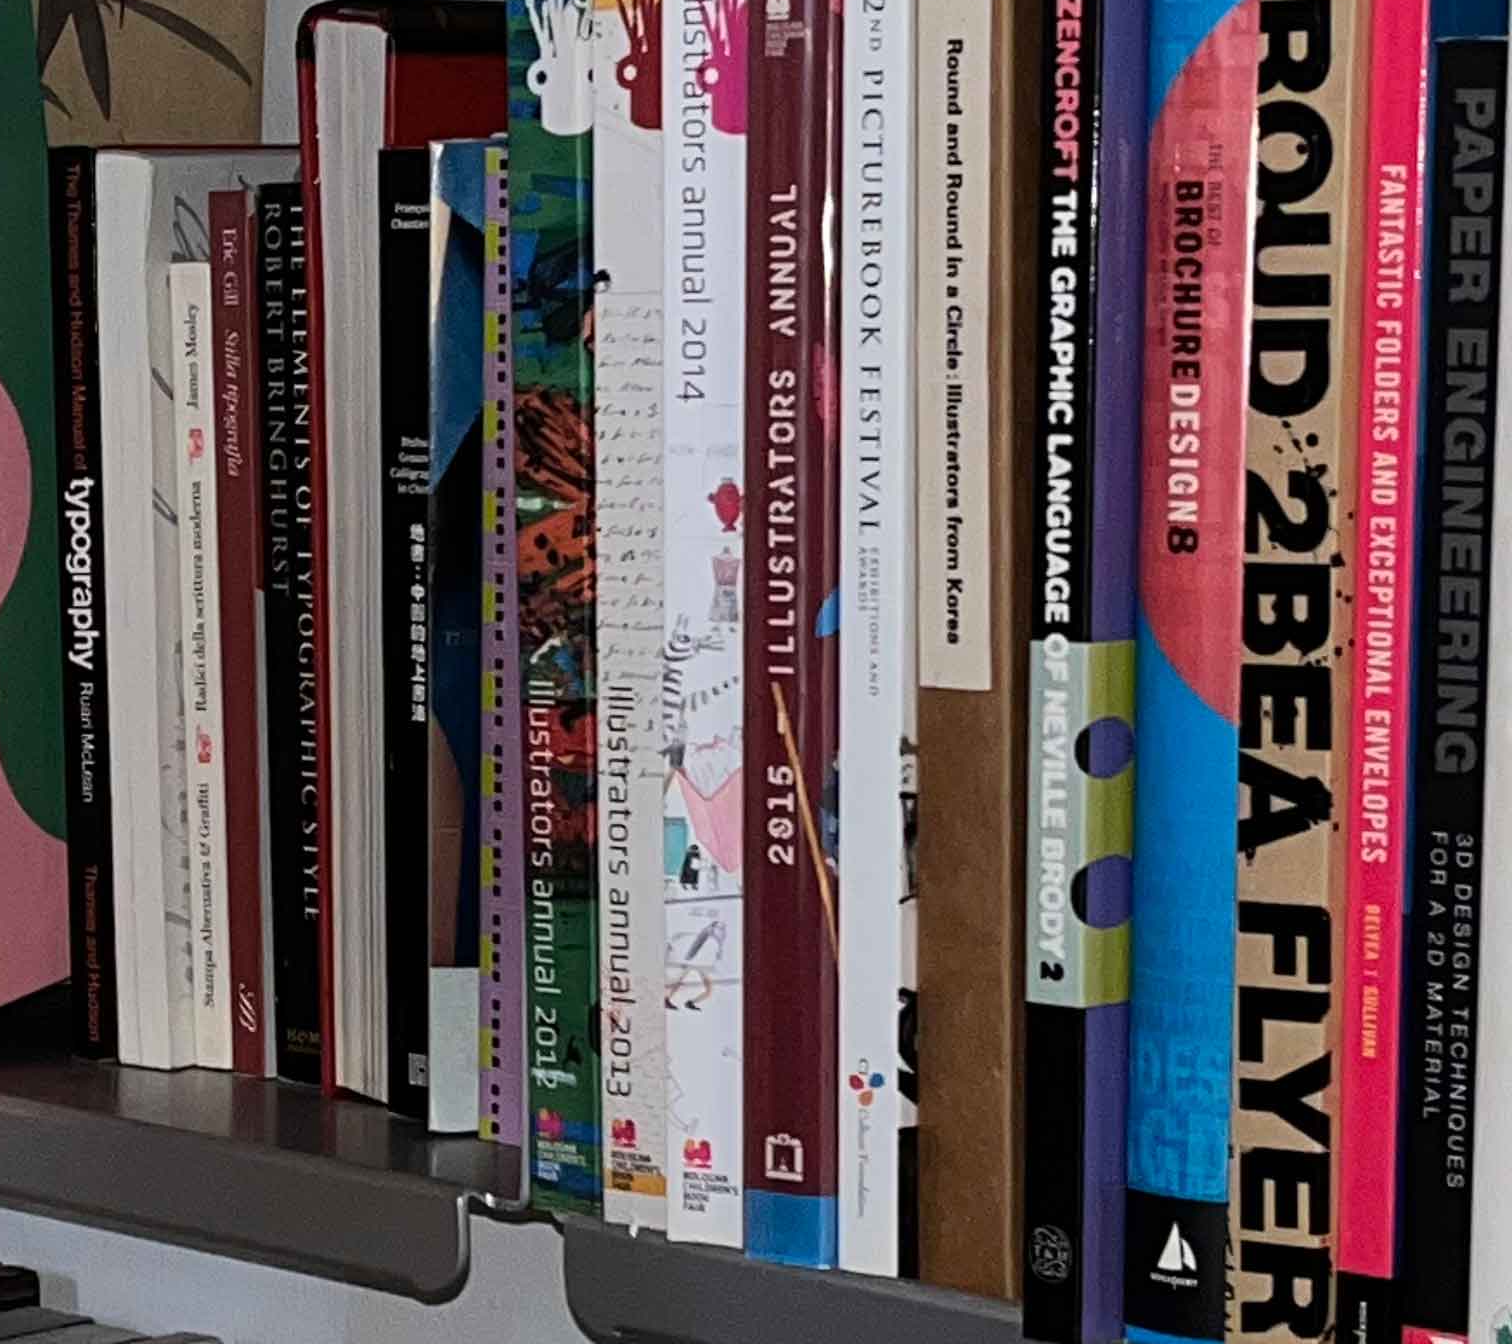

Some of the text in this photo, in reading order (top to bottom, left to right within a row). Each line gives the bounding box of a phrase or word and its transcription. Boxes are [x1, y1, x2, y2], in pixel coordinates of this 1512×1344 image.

[945, 38, 964, 116] Round
[946, 123, 964, 166] and
[681, 186, 713, 305] annual
[945, 172, 963, 251] Round
[946, 256, 963, 280] in
[1051, 190, 1078, 259] THE
[946, 285, 959, 299] a
[1048, 267, 1076, 424] GRAPHIC
[263, 203, 290, 600] ROBERT BRINGHURST
[675, 317, 708, 404] 2014
[769, 184, 797, 674] ILLUSTRATORS ANNUAL
[945, 385, 963, 509] Illustrators
[1434, 88, 1496, 775] PAPER ENGINEERING
[945, 515, 962, 571] from
[1044, 433, 1074, 624] LANGUAGE
[1360, 164, 1406, 863] FANTASTIC FOLDERS AND EXCEPTIONAL ENVELOPES
[945, 577, 962, 645] Korea
[1041, 633, 1069, 685] OF
[1038, 688, 1070, 846] NEVILLE
[527, 679, 560, 1089] Illustrators annual 2012
[606, 686, 635, 1097] Illustrators annual 2013
[1037, 854, 1068, 958] BRODY
[1038, 959, 1066, 982] 2
[1422, 831, 1447, 1120] FOR A 2D MATERIAL
[1446, 832, 1475, 1190] 3D DESIGN TECHNIQUES
[1237, 902, 1337, 1342] FLYER
